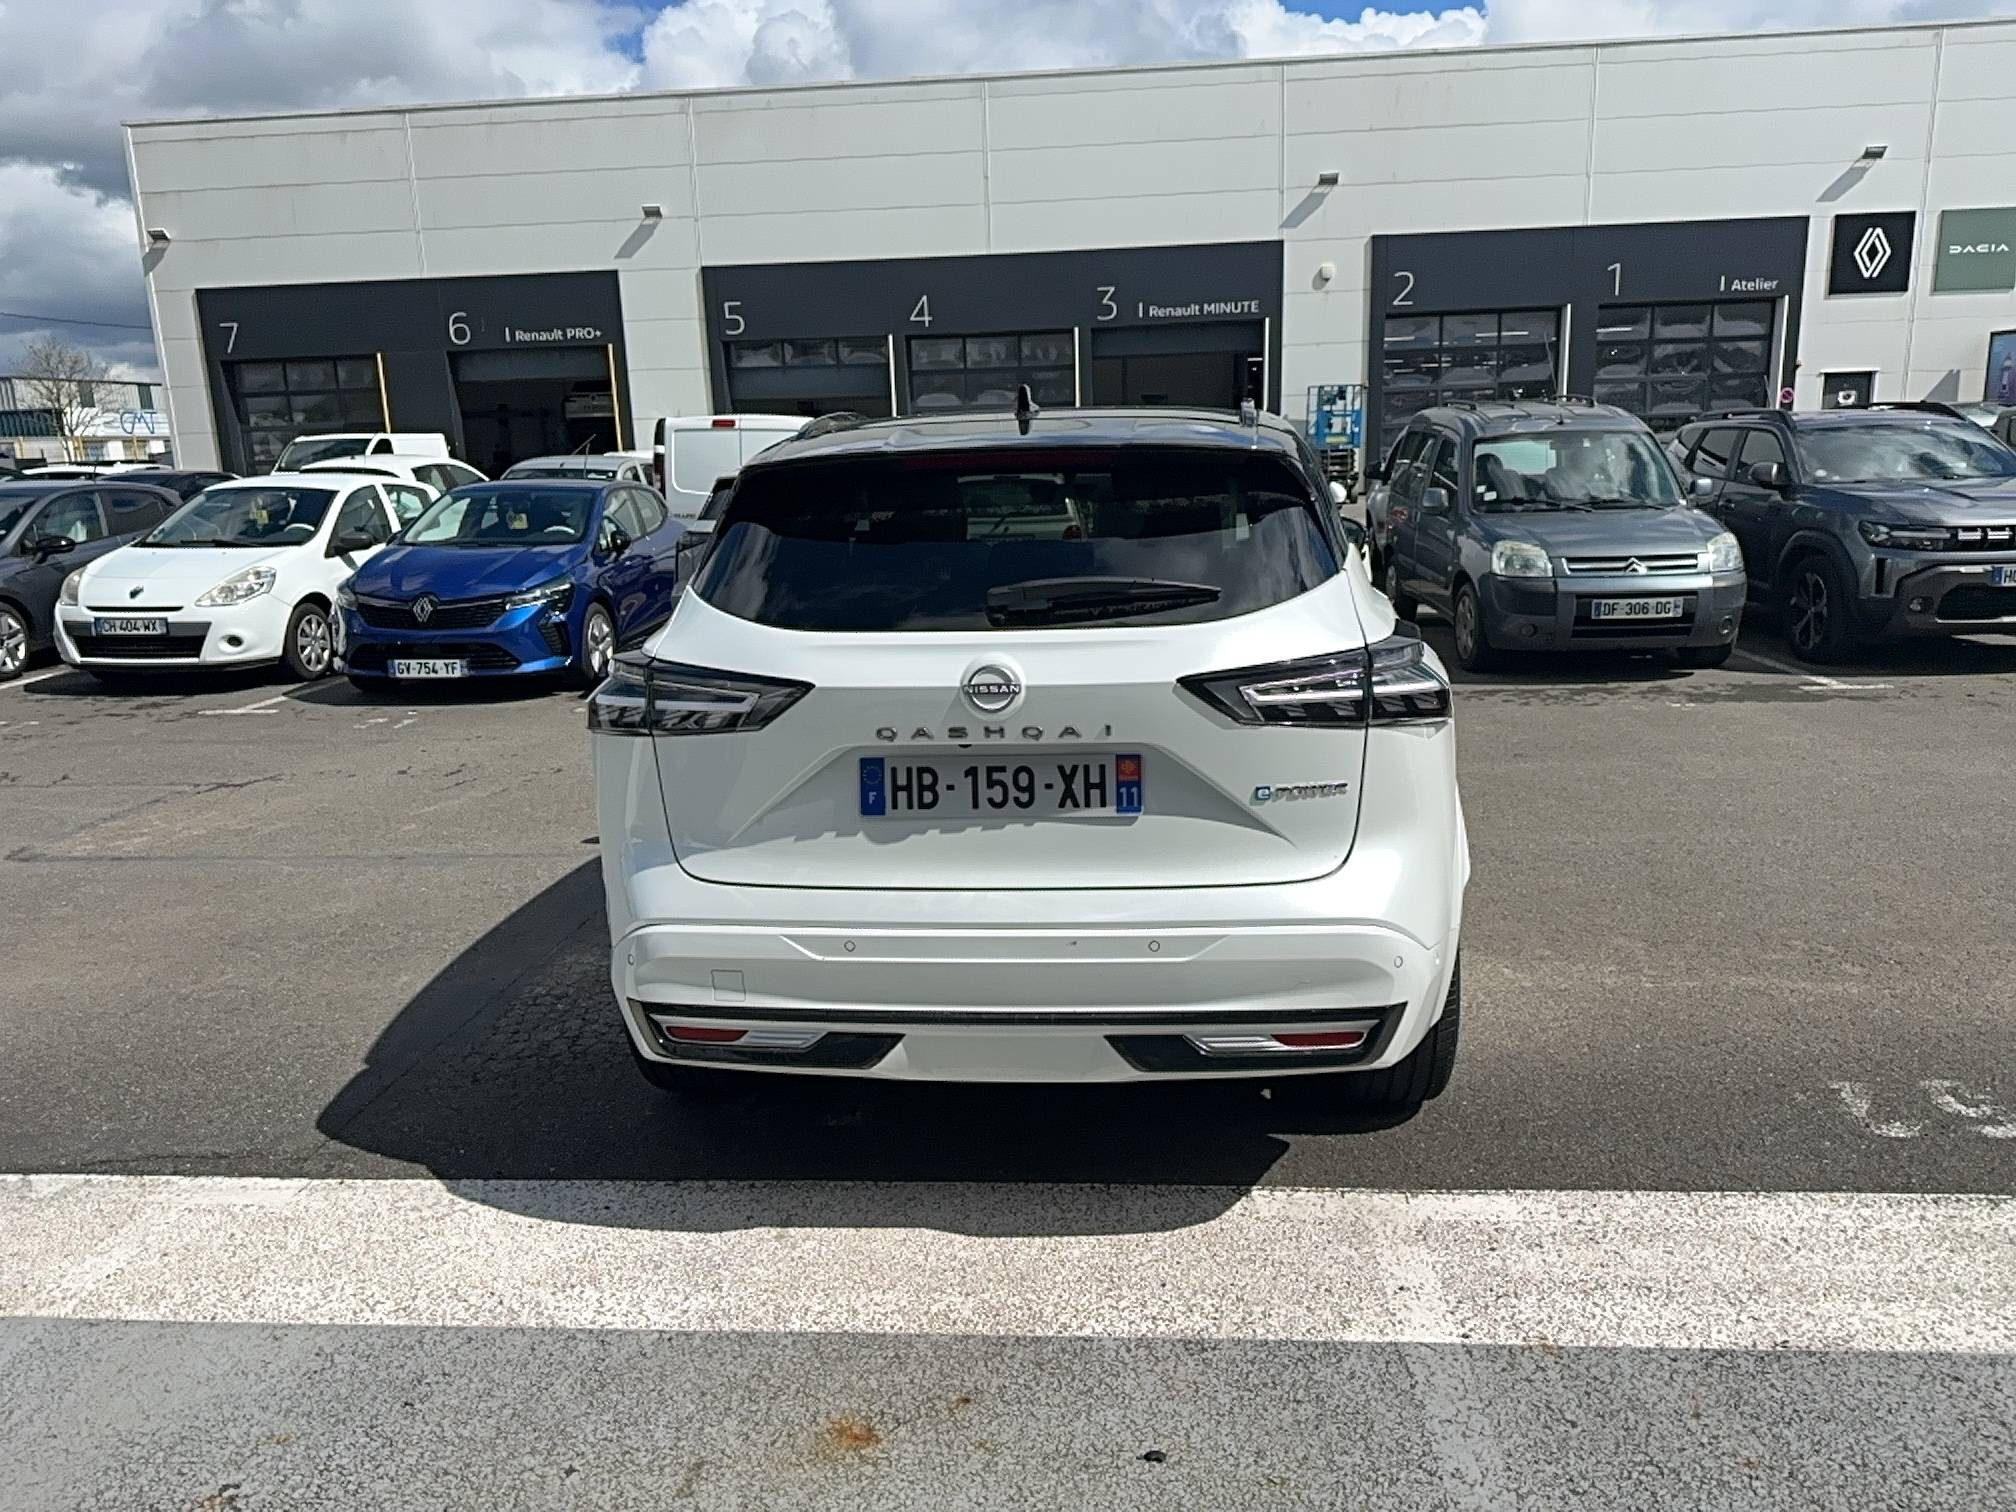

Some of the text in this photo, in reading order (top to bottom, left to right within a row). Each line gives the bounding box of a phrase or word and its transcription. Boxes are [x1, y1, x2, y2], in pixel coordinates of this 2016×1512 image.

[1949, 243, 2009, 254] DACIA
[1392, 271, 1415, 305] 2
[1607, 263, 1621, 296] 1
[1731, 277, 1779, 291] Atelier
[909, 294, 932, 328] 4
[1097, 286, 1117, 321] 3
[1149, 300, 1259, 317] Renault MINUTE
[448, 312, 471, 345] 6
[723, 301, 745, 336] 5
[219, 322, 239, 353] 7
[515, 328, 563, 342] Renault
[963, 684, 1019, 694] NISSAN
[876, 724, 1112, 741] QASHQAI
[868, 792, 876, 804] F
[890, 763, 1107, 810] HB-159-XH
[1119, 786, 1138, 807] 11
